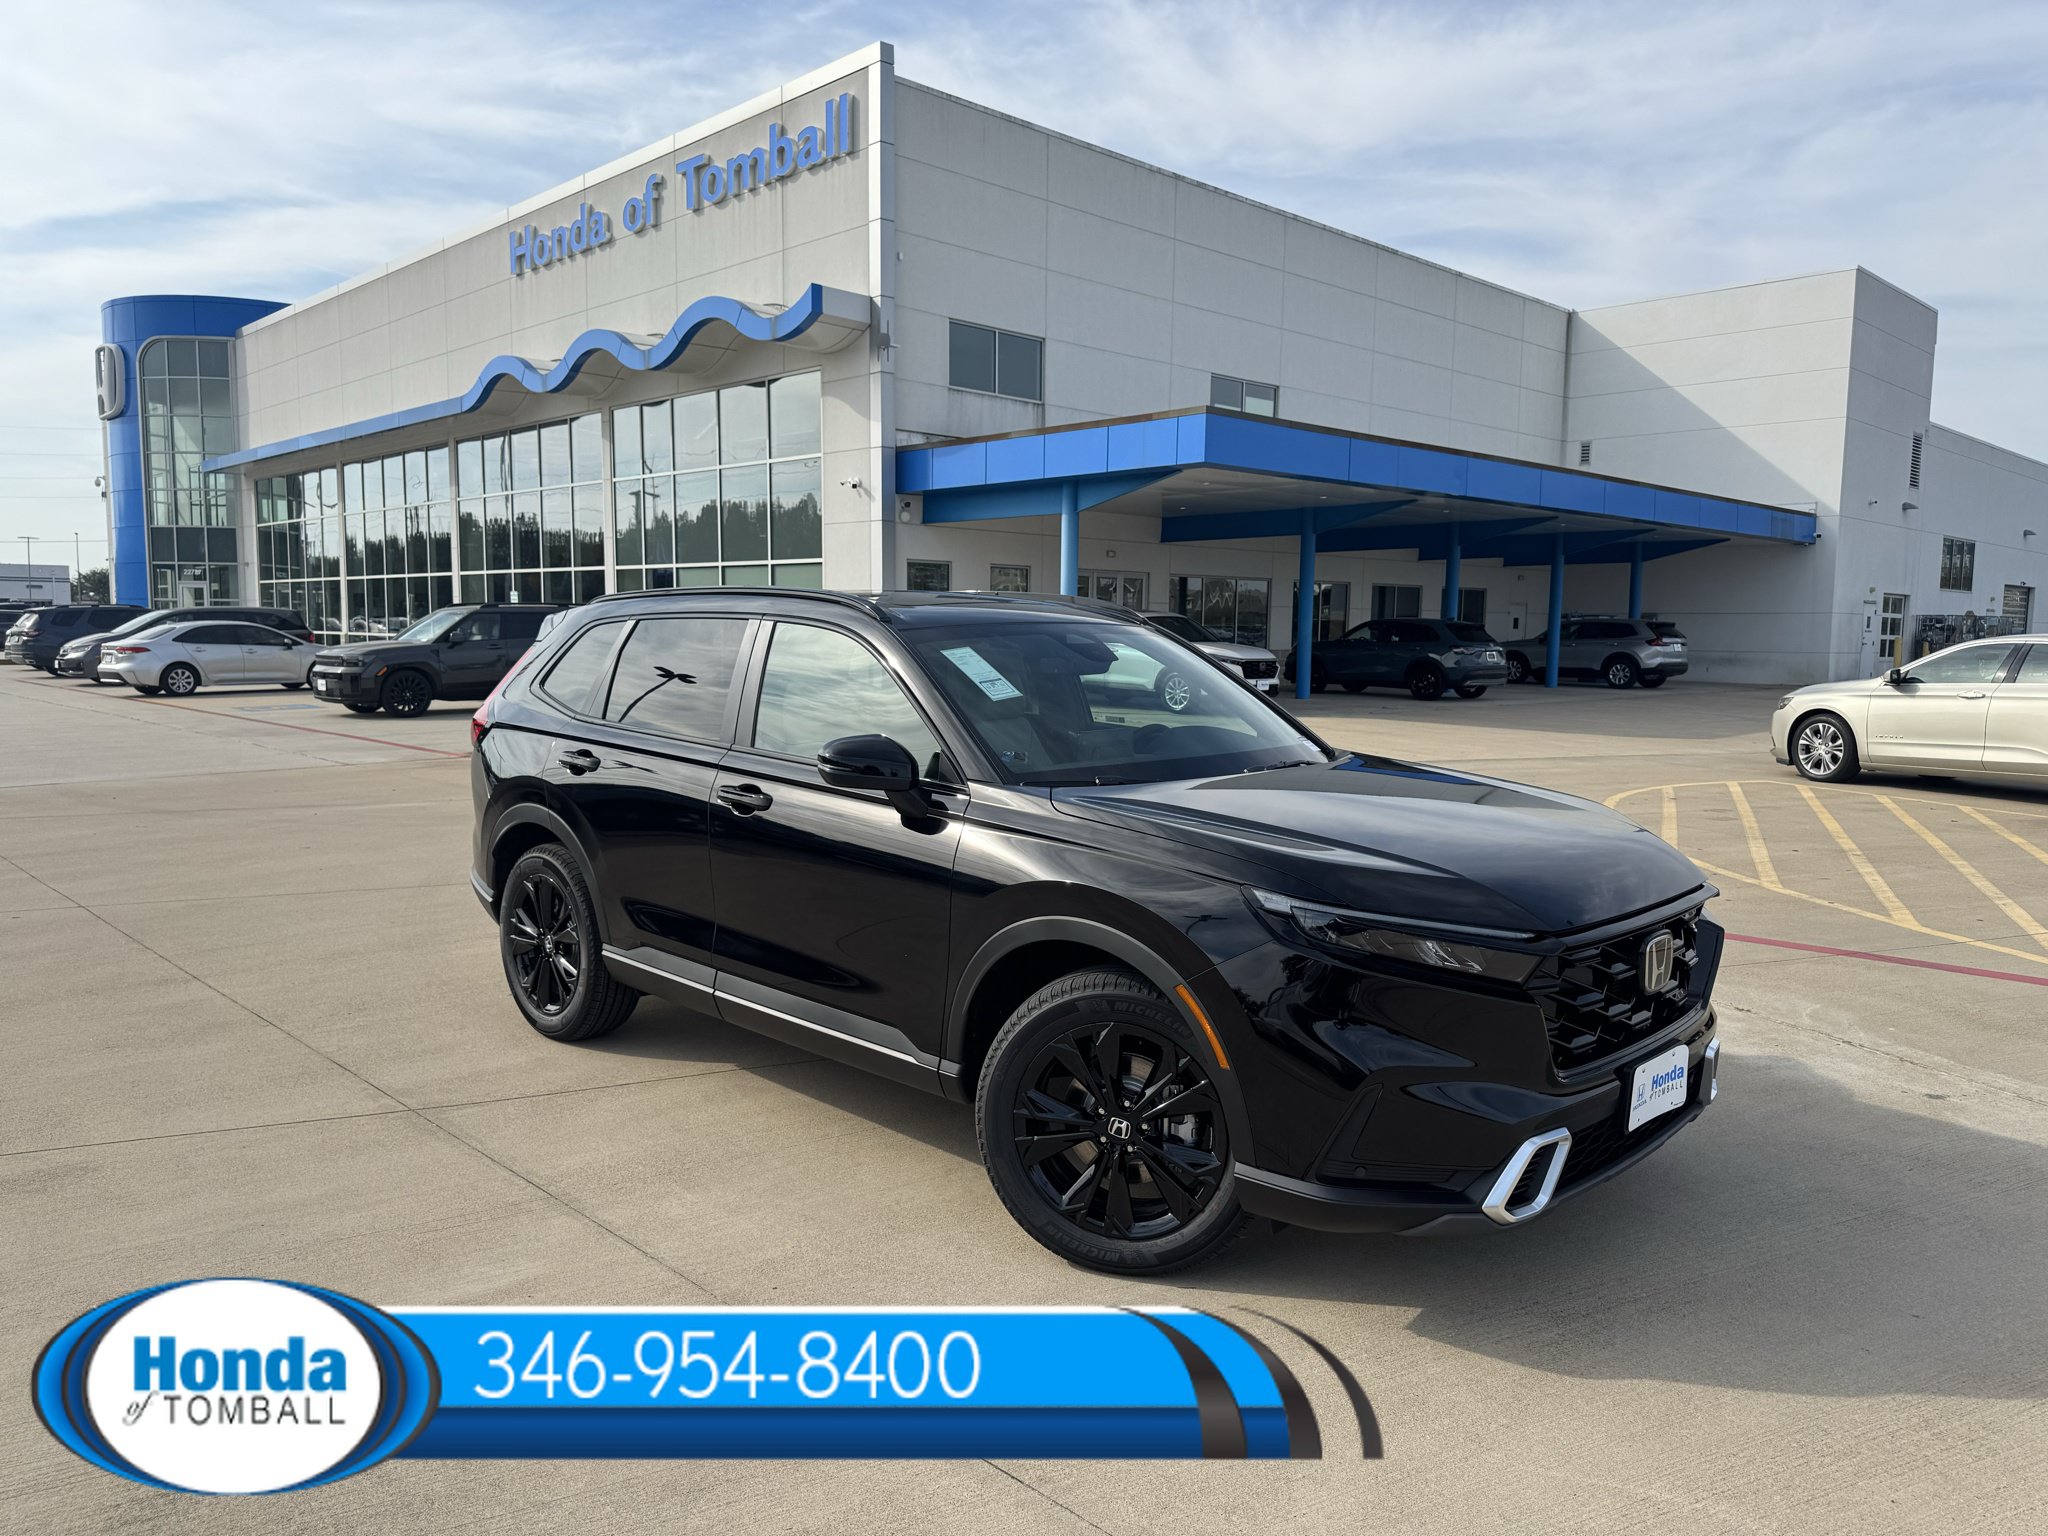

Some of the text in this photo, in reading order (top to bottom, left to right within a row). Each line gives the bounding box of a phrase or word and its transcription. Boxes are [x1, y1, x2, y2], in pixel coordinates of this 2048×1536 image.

[509, 92, 854, 275] Honda of Tomball
[1651, 1065, 1684, 1091] Honda
[1655, 1082, 1683, 1099] TOMBALL
